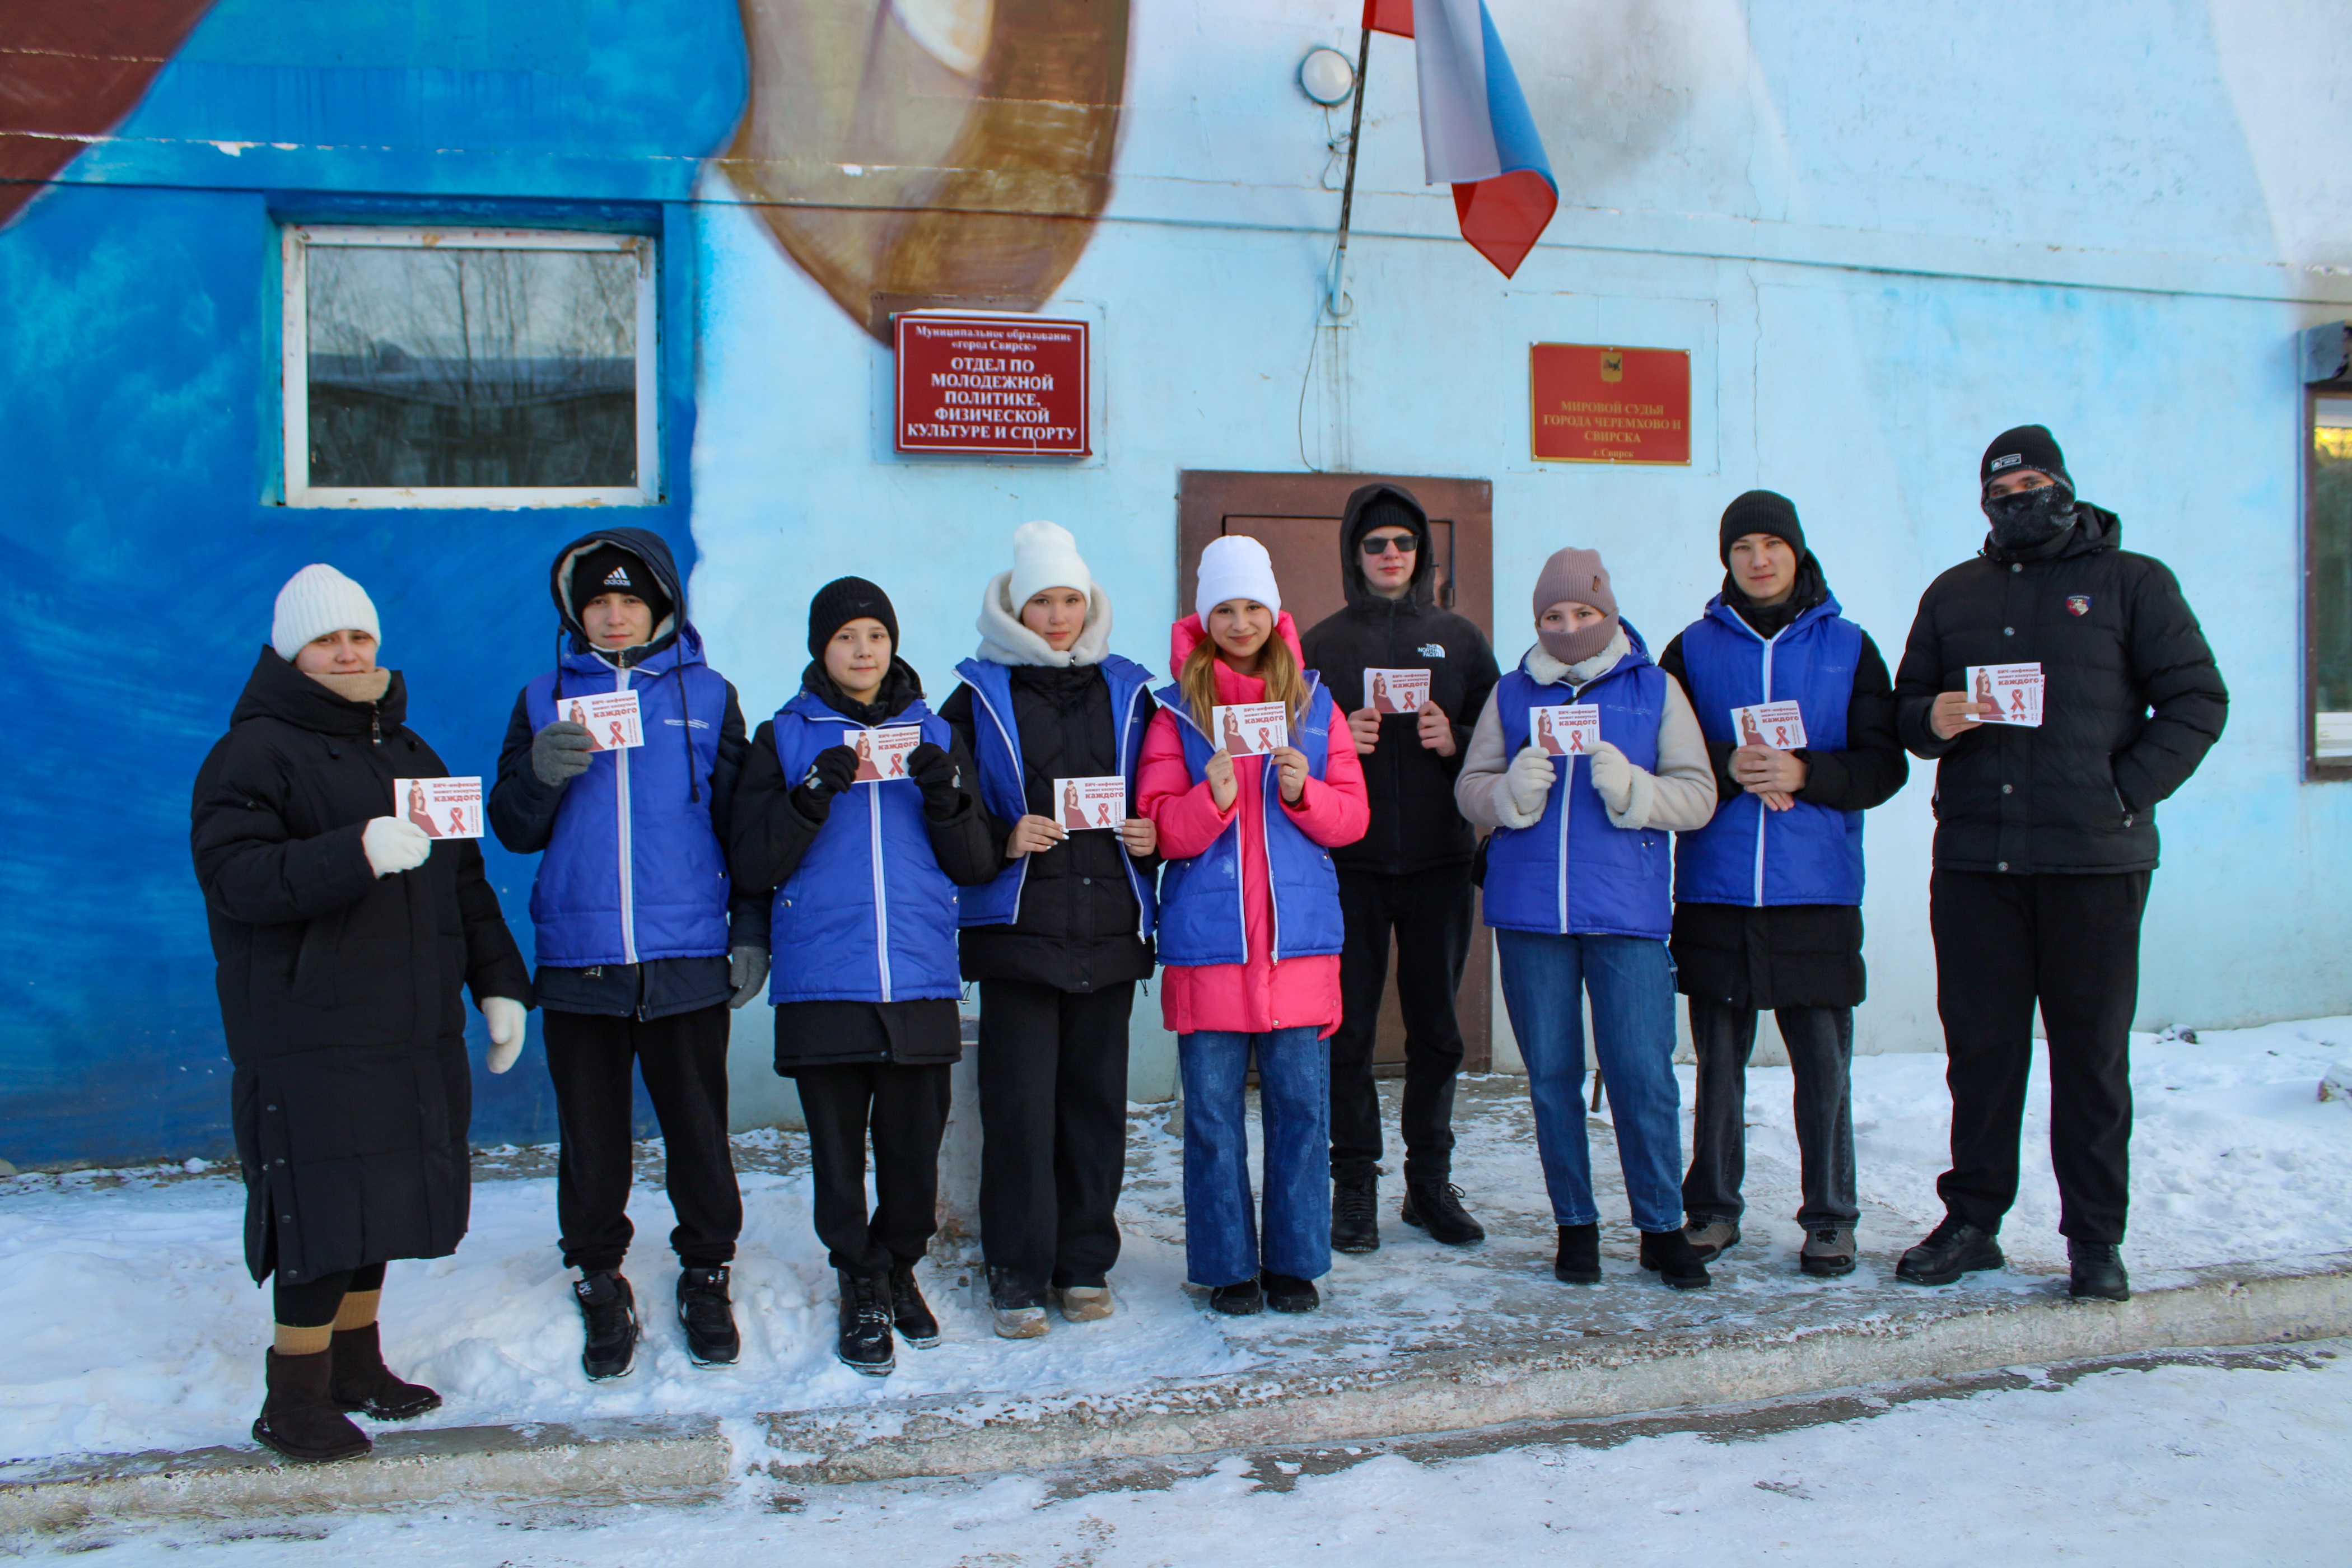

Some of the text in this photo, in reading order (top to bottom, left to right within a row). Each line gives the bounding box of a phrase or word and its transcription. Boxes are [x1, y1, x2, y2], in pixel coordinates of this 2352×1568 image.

[916, 325, 1072, 342] Муниципальное образование
[952, 340, 1037, 353] «город Свирск»
[951, 357, 1035, 372] ОТДЕЛ ПО
[931, 374, 1054, 391] МОЛОДЕЖНОЙ
[945, 391, 1041, 407] ПОЛИТИКЕ,
[935, 407, 1050, 423] ФИЗИЧЕСКОЙ
[1561, 400, 1664, 416] МИРОВОЙ СУДЬЯ
[1543, 414, 1681, 430] ГОРОДА ЧЕРЕМХОВО И
[907, 423, 1076, 441] КУЛЬТУРЕ И СПОРТУ
[1584, 431, 1641, 443] СВИРСКА
[1601, 448, 1634, 458] Свирск
[594, 708, 637, 718] каждого
[1245, 715, 1284, 724] каждого
[879, 741, 918, 750] каждого
[434, 794, 481, 802] каждого
